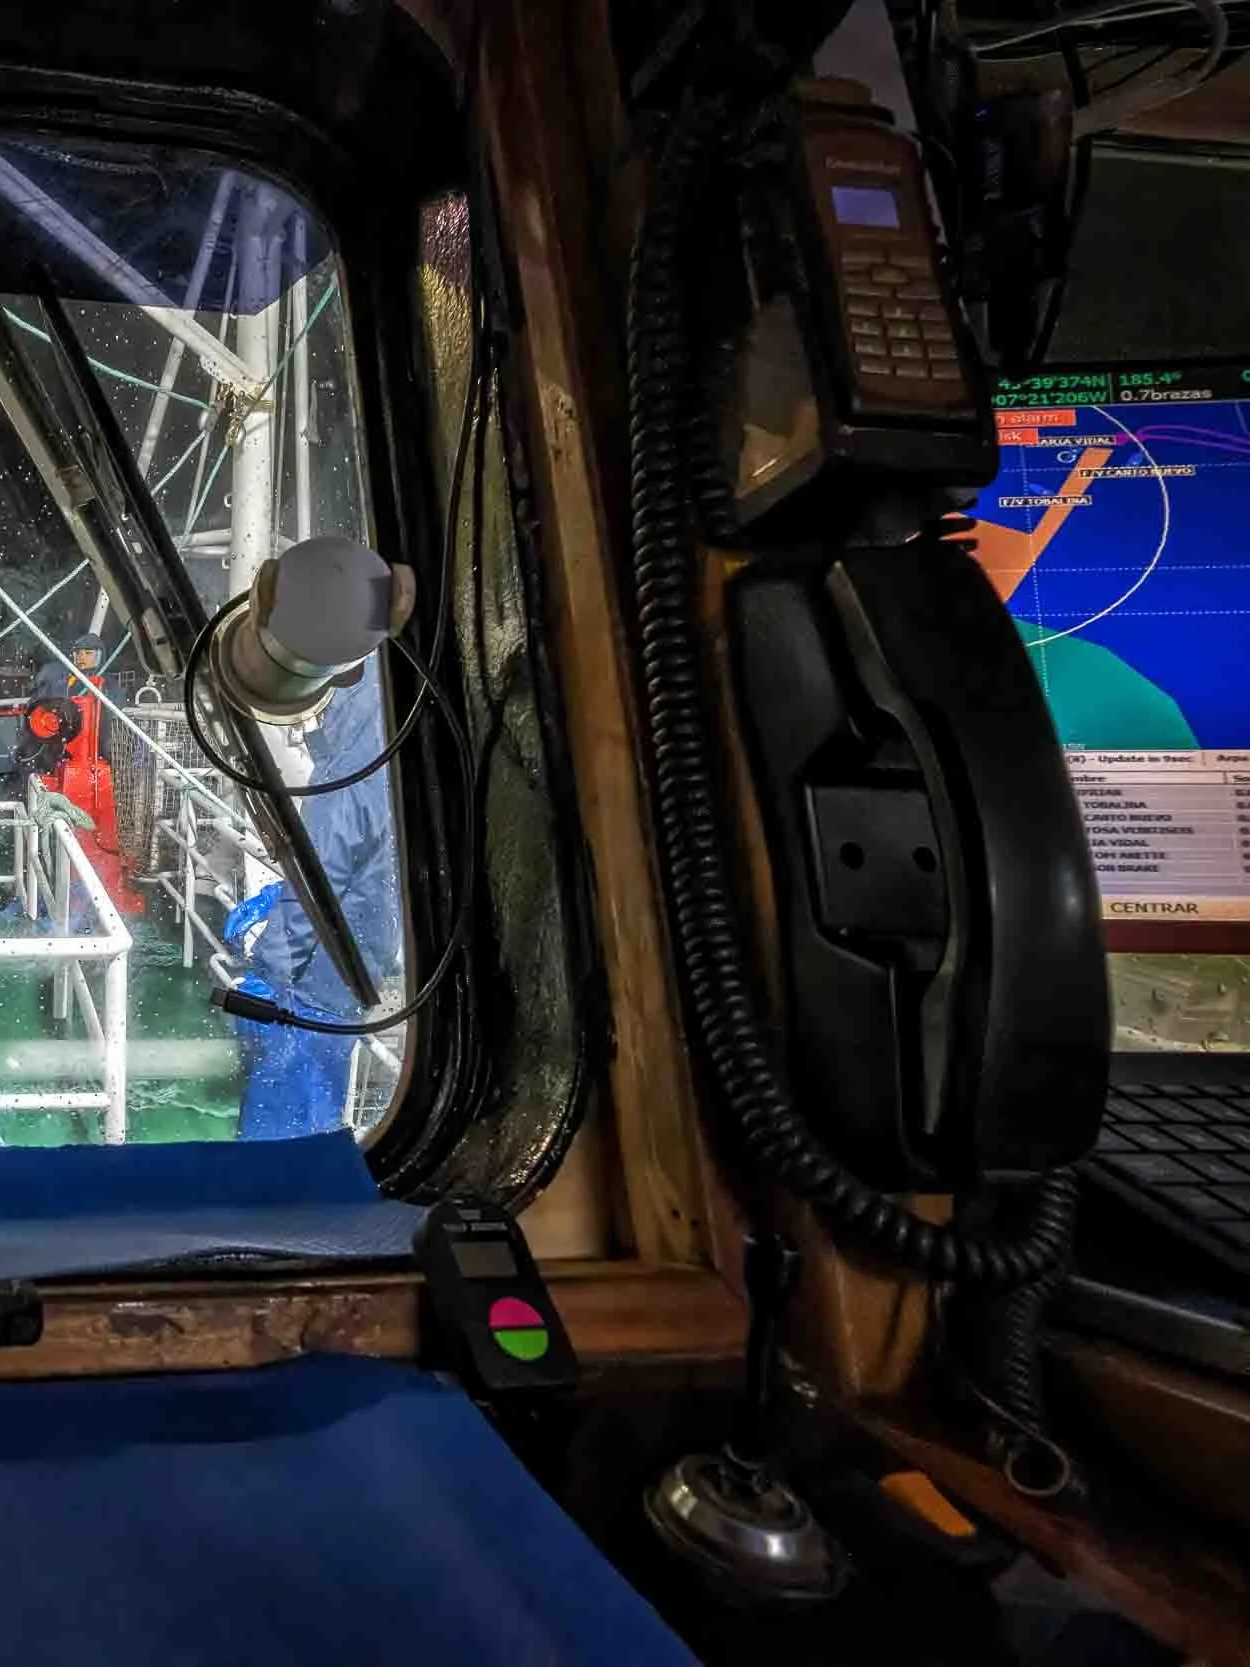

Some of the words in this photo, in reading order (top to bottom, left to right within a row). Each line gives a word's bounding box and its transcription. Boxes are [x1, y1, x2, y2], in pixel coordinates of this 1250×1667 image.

[1120, 389, 1213, 401] 0.7brazas
[1098, 755, 1145, 764] Update
[1110, 839, 1150, 847] VIDAL
[1110, 902, 1199, 914] CENTRAR
